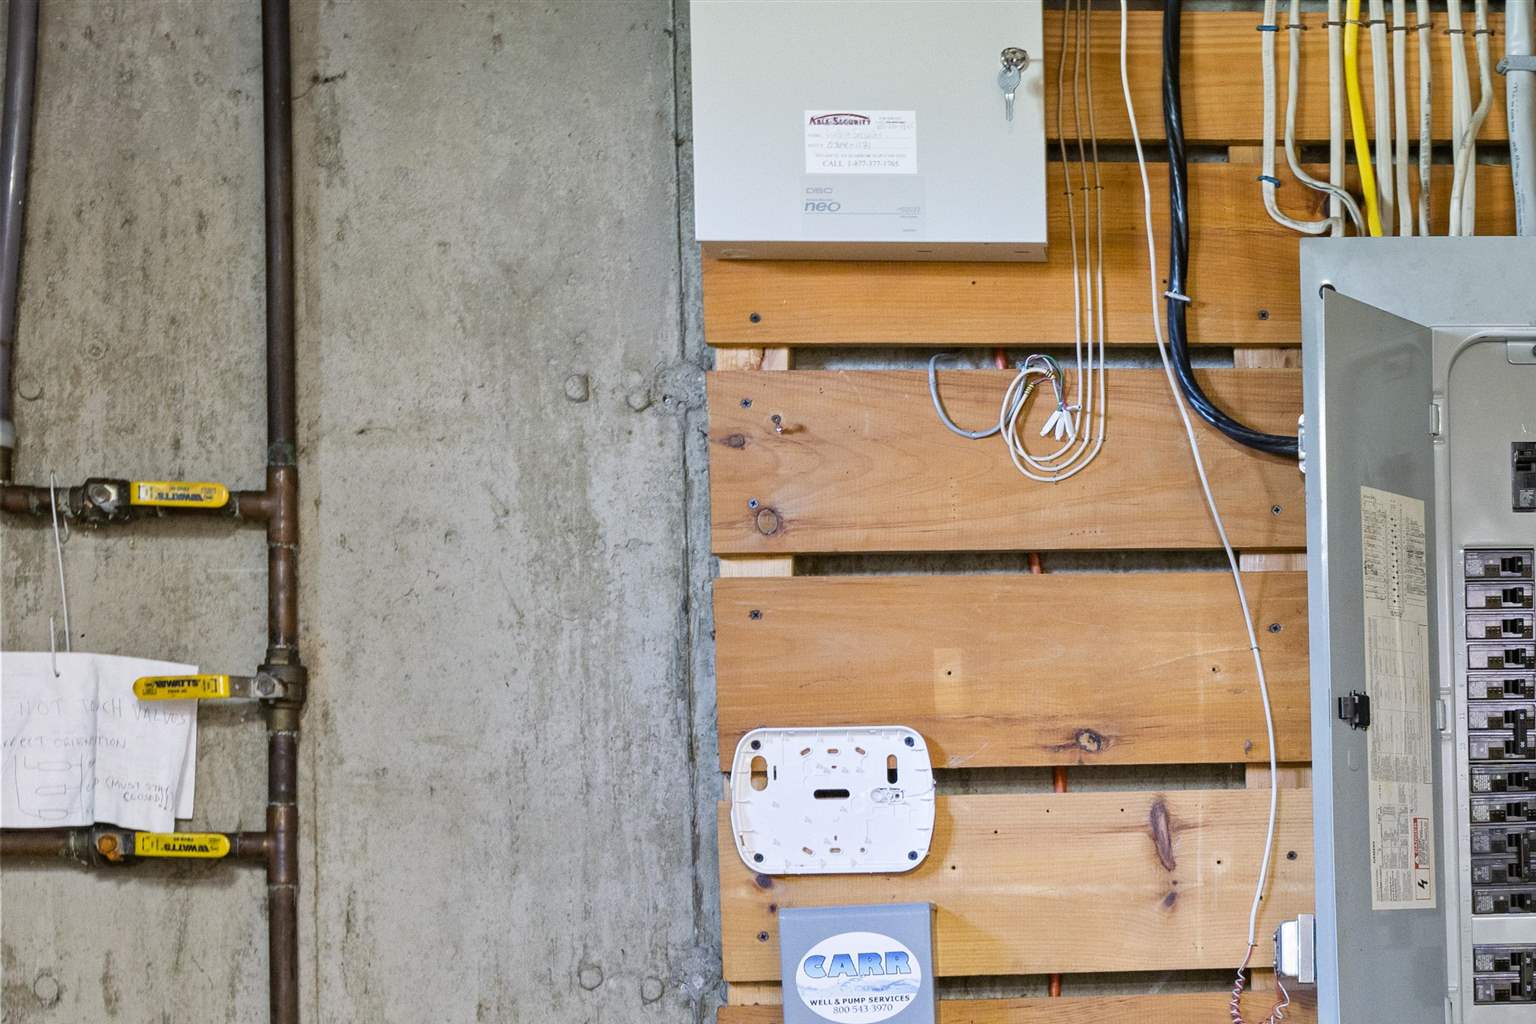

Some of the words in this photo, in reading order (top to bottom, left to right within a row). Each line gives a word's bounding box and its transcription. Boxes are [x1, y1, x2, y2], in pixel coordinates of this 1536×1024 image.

[804, 951, 912, 979] CARR
[810, 999, 832, 1007] WELL
[842, 997, 866, 1005] PUMP
[868, 995, 911, 1004] SERVICES
[832, 1006, 850, 1015] 800
